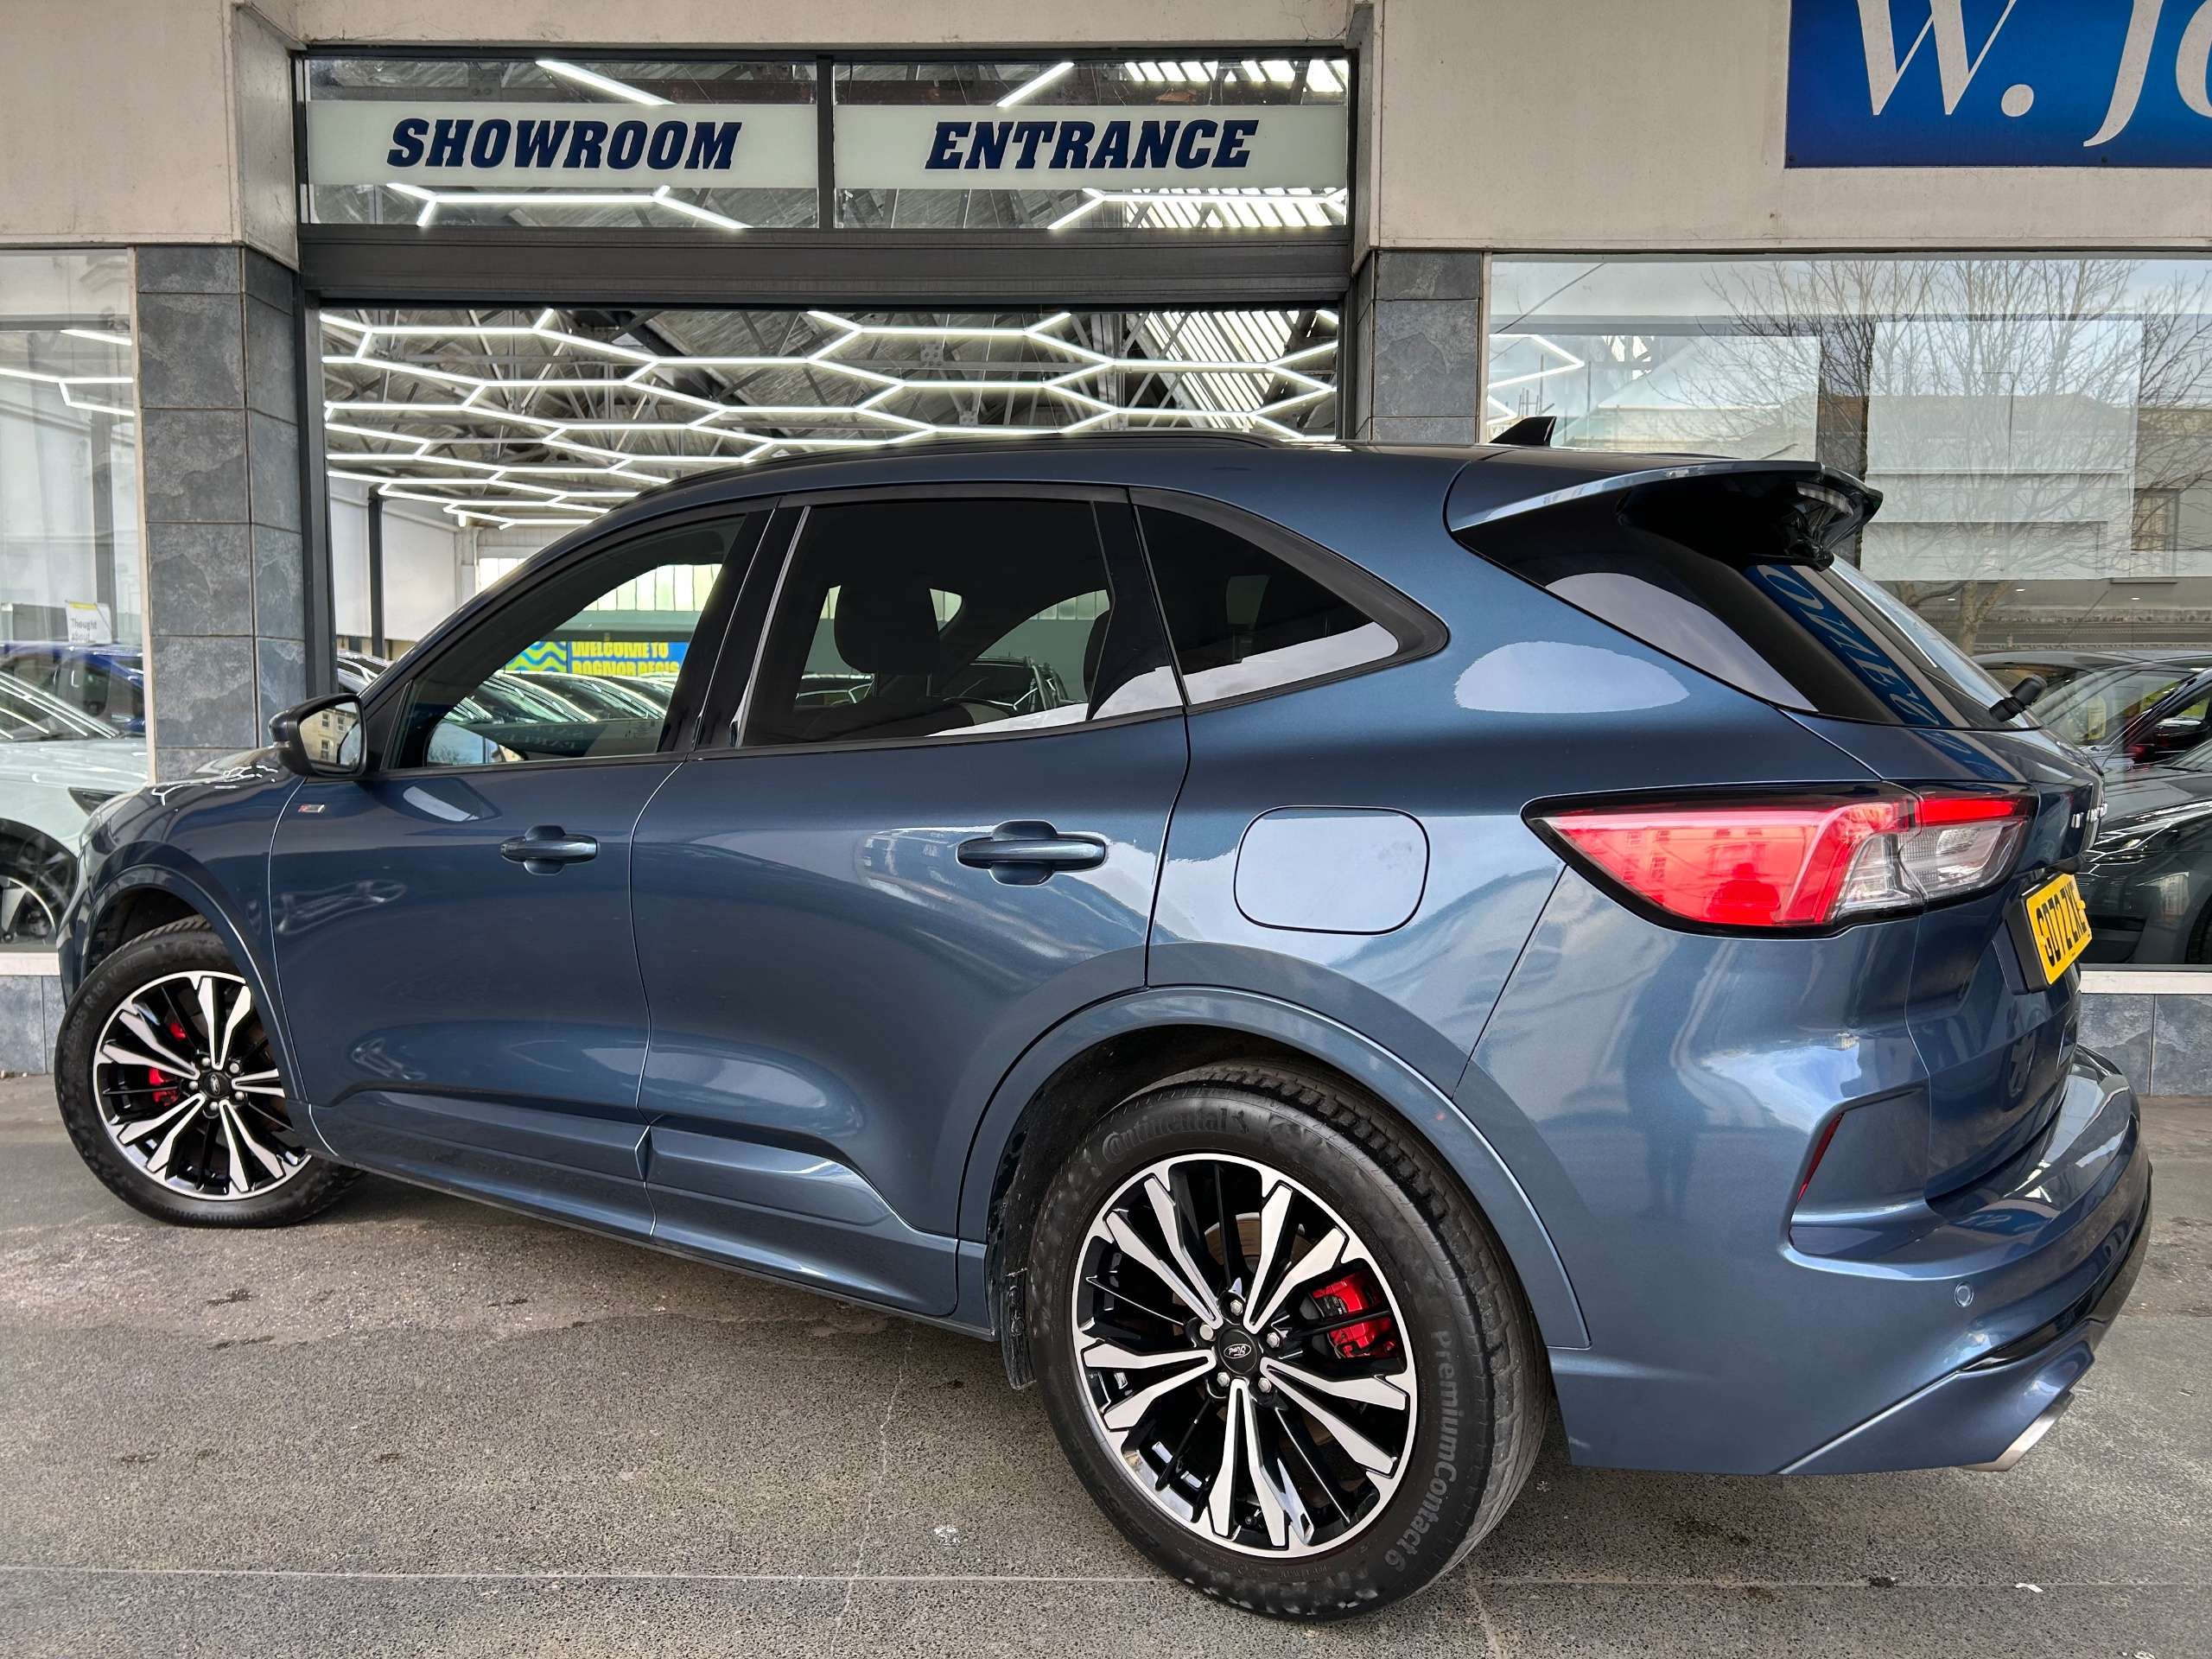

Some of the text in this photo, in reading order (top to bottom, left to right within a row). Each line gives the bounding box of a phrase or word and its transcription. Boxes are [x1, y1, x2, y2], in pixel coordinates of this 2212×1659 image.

[385, 118, 742, 170] SHOWROOM
[925, 119, 1259, 170] ENTRANCE
[571, 641, 669, 658] WELCOME TO
[1384, 1331, 1465, 1572] PremiumContact 6
